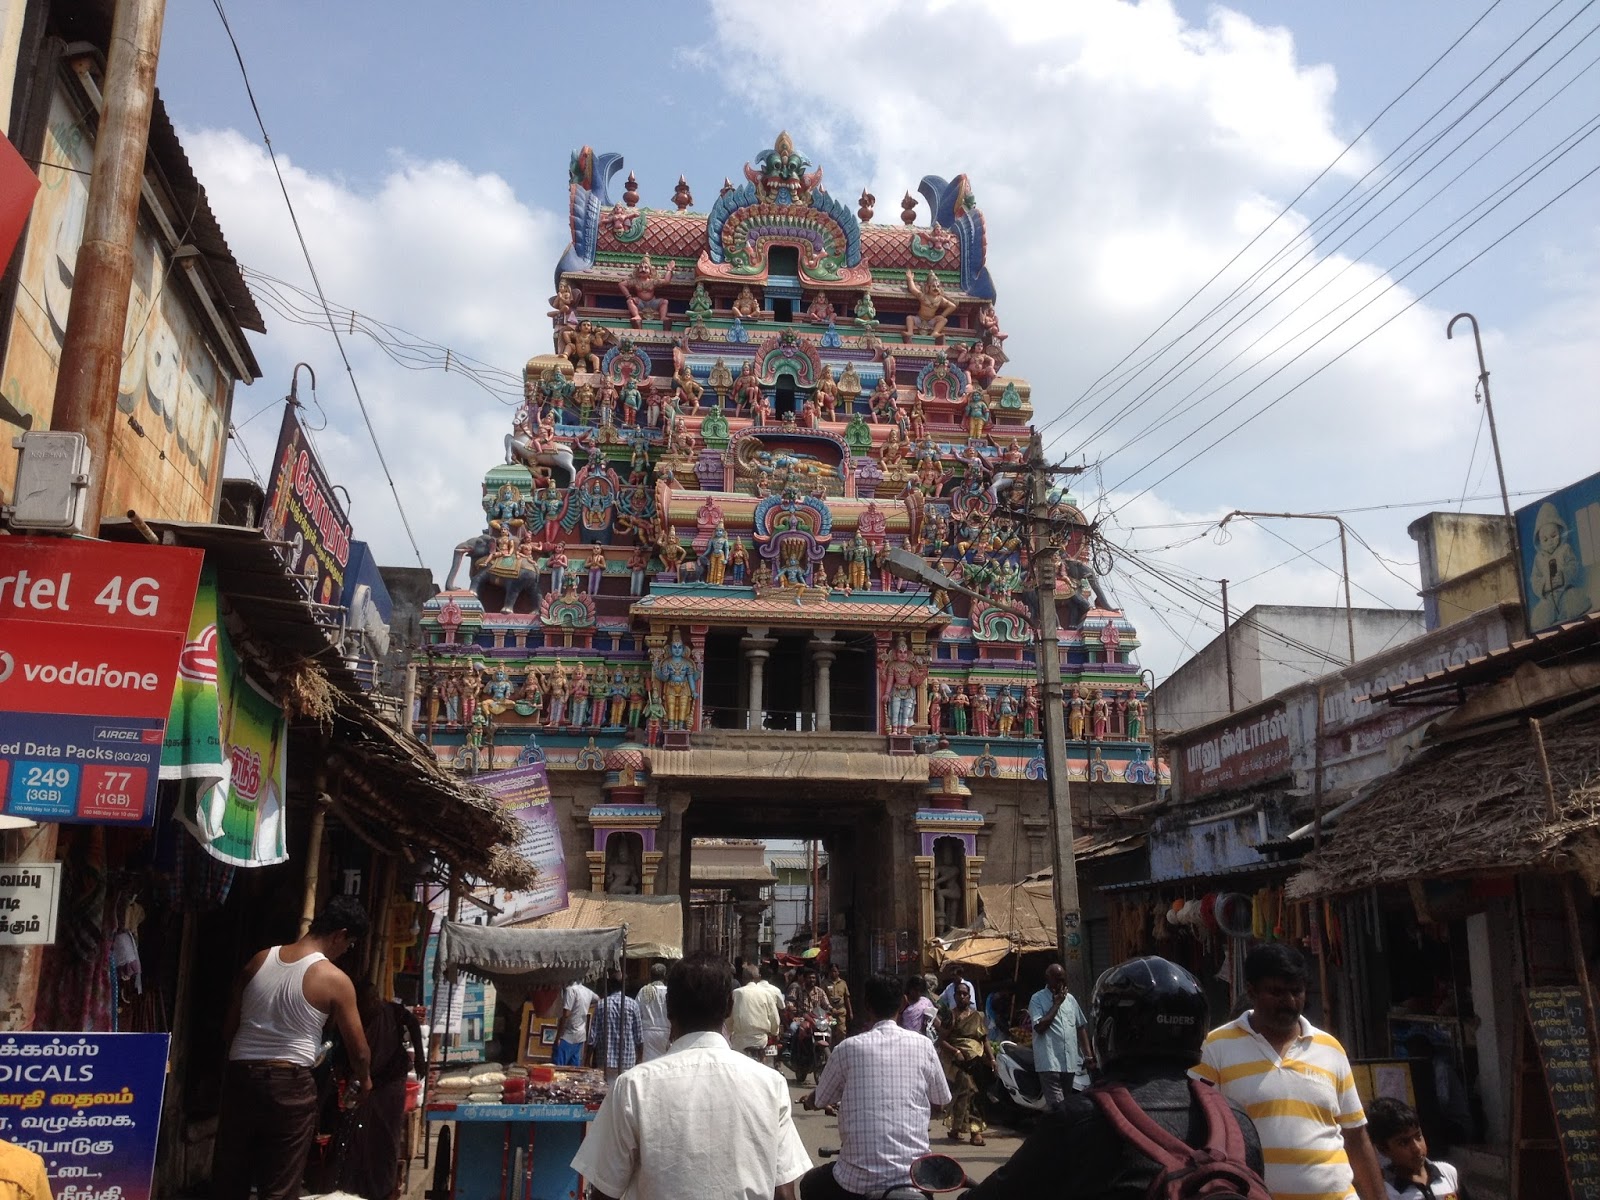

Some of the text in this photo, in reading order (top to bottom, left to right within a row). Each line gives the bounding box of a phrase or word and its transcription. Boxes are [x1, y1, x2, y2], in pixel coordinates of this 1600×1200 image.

[94, 575, 160, 617] 4G
[23, 660, 158, 691] vodafone
[97, 730, 140, 740] AIRCEL
[0, 742, 151, 763] ed Data Packs (3G/2G)
[26, 788, 62, 803] (3GB)
[95, 792, 130, 807] (1GB)
[1156, 1014, 1195, 1025] GLIDERS
[50, 1086, 135, 1110] தைலம்
